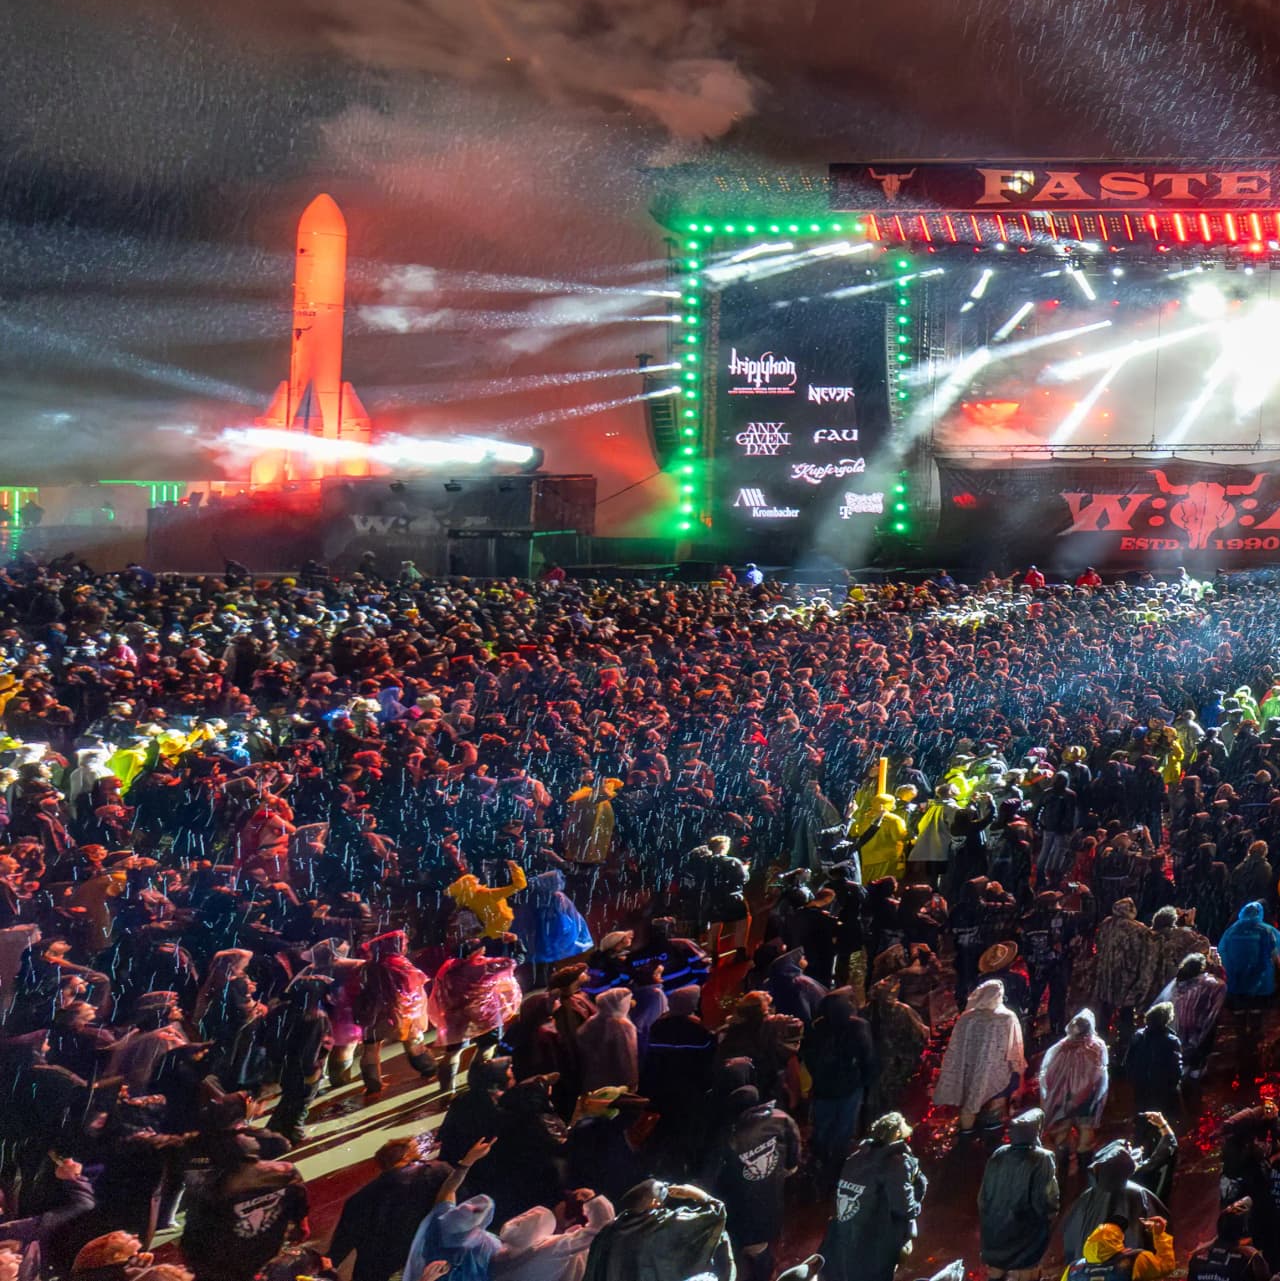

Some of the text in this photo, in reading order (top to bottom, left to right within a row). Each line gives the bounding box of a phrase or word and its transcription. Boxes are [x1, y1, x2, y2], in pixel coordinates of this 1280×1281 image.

[747, 422, 785, 433] ANY
[735, 433, 792, 445] GIVEN
[745, 445, 780, 456] DAY
[753, 507, 800, 518] Krombacher
[1120, 535, 1280, 551] ESTD. 1990
